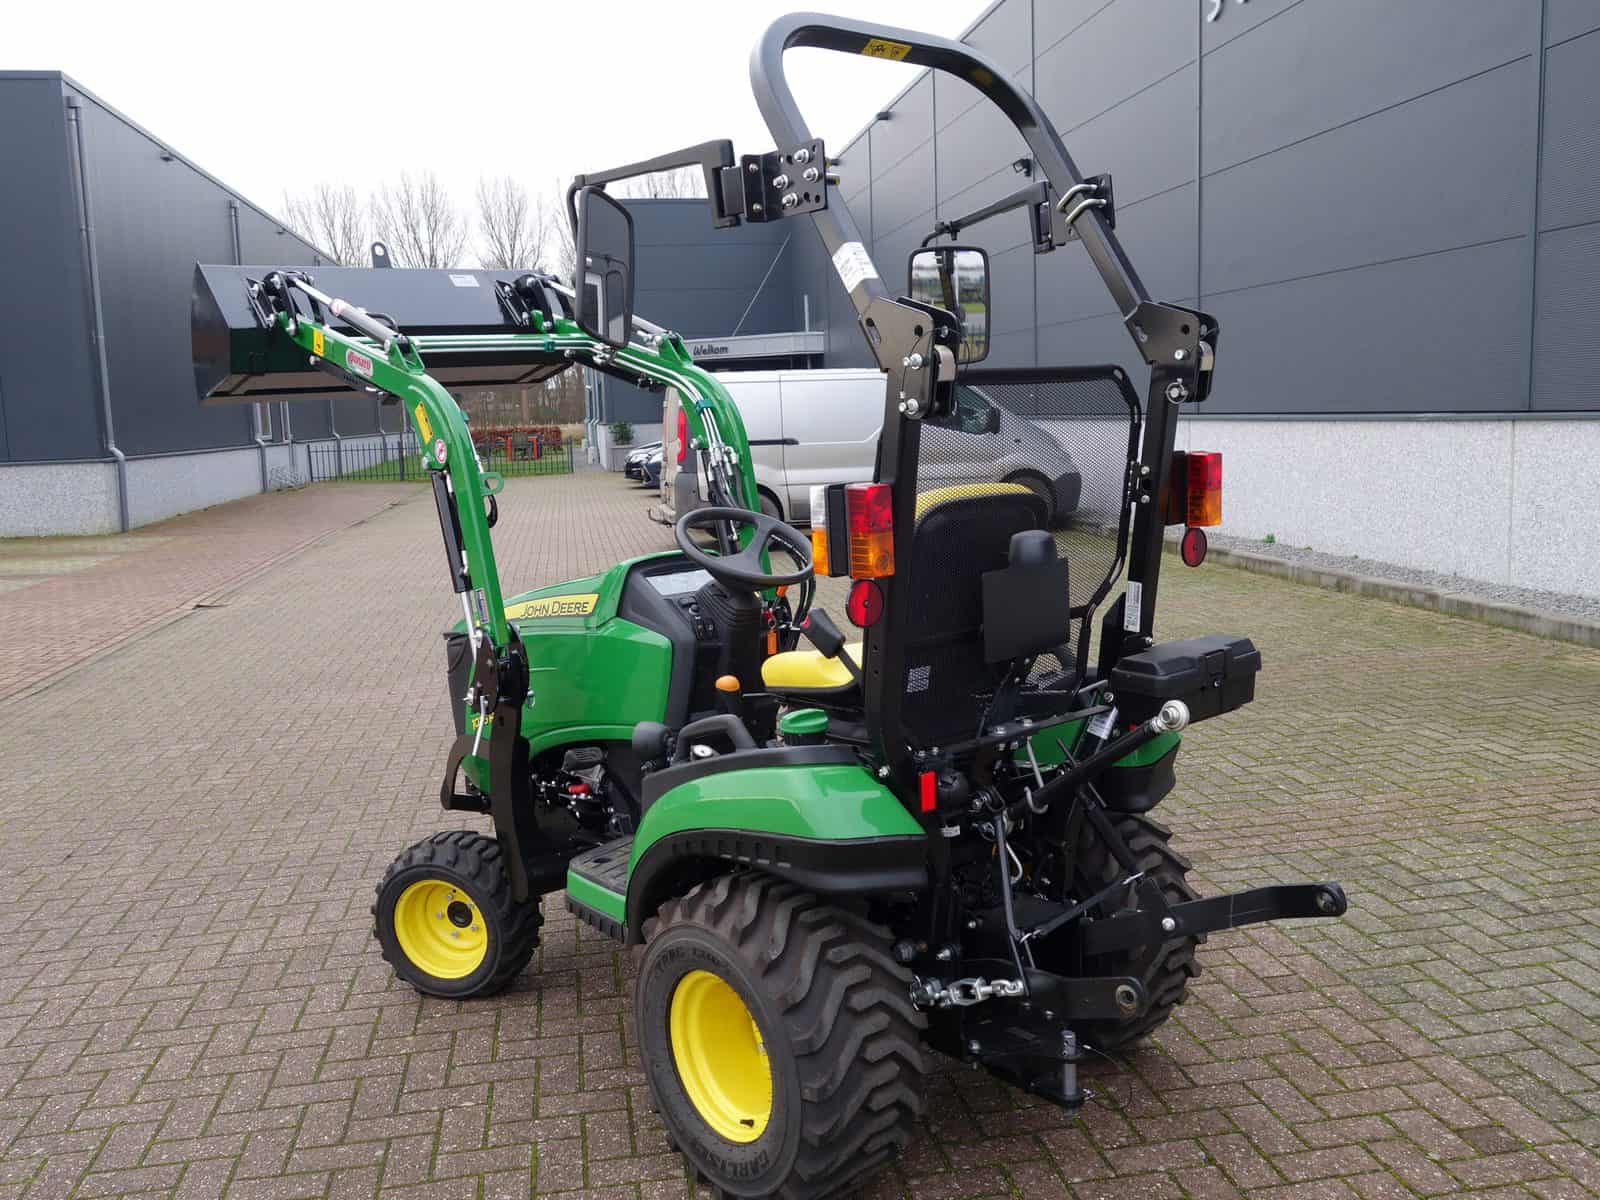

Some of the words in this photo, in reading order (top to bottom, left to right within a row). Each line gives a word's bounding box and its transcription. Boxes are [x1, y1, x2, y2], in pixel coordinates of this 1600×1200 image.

[693, 343, 729, 356] Welkom
[520, 603, 551, 618] JOHN
[551, 601, 590, 614] DEERE
